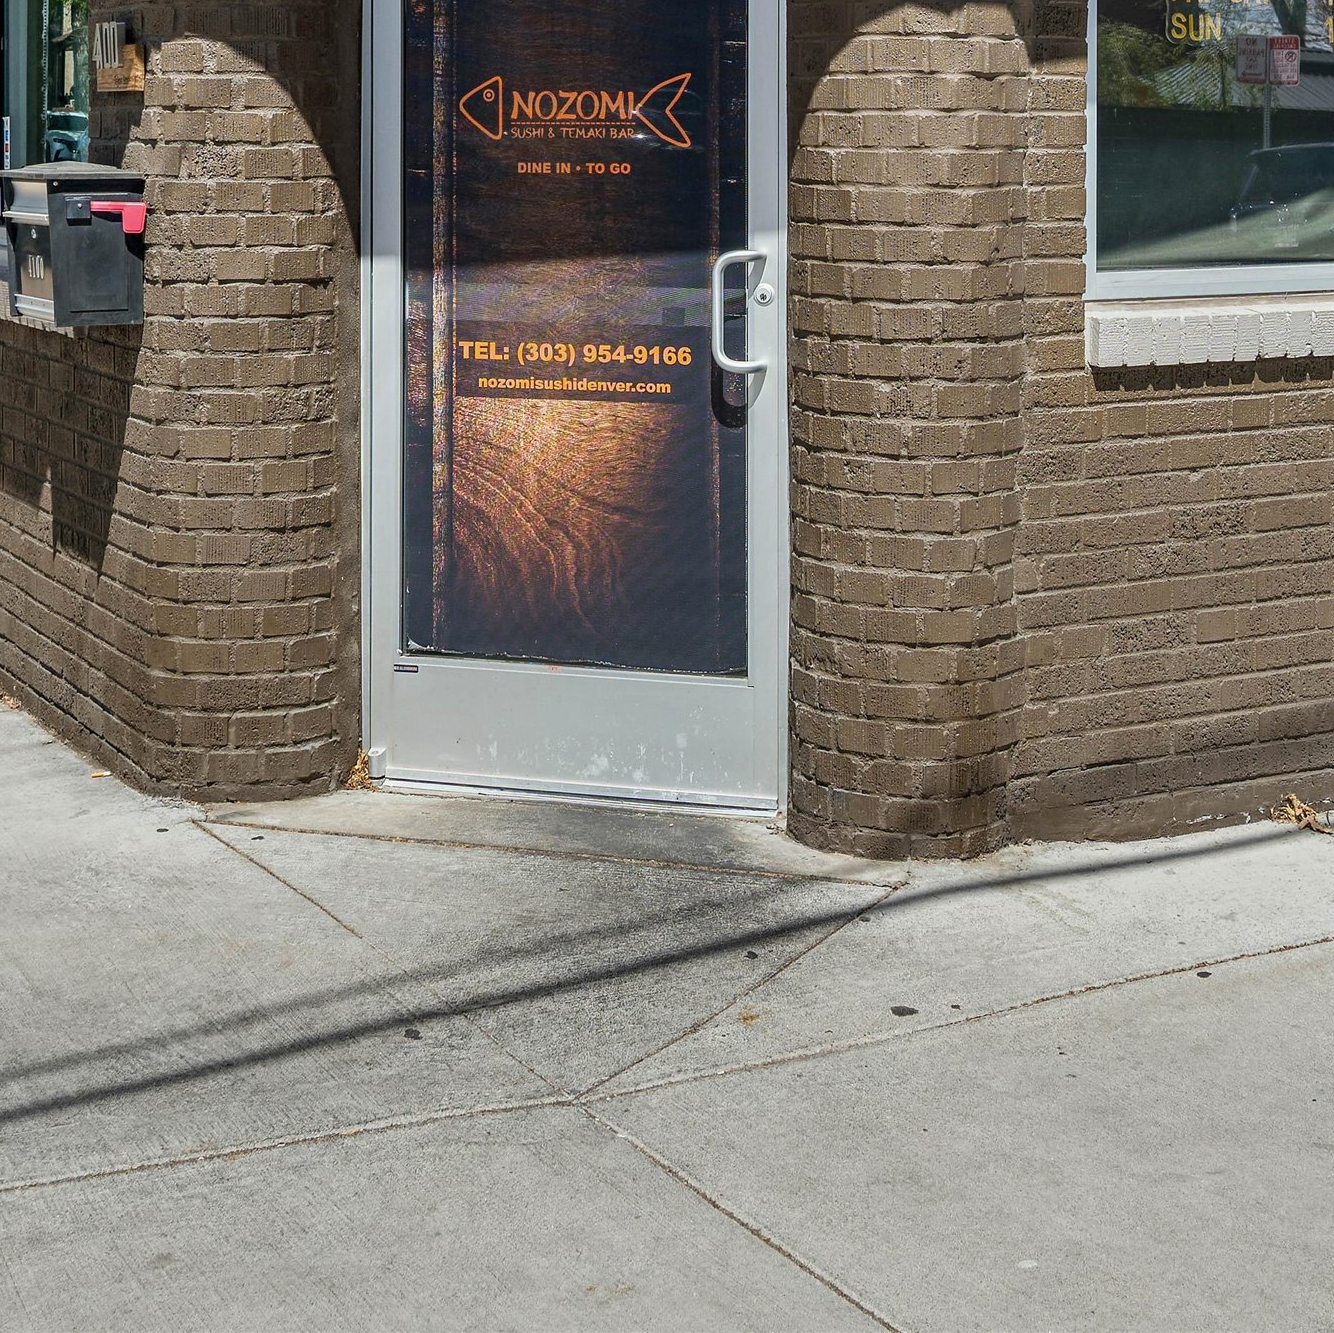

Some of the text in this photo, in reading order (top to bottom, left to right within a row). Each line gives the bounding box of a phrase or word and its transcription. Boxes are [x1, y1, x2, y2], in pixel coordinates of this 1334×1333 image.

[1171, 13, 1222, 41] SUN
[510, 90, 635, 120] NOZOMI
[511, 127, 636, 139] SUSHI & TEMAKI BAR
[517, 162, 631, 175] DINE IN TO GO
[459, 341, 692, 366] TEL: (303) 954-9166
[478, 377, 671, 393] nozomisushidenver.com
